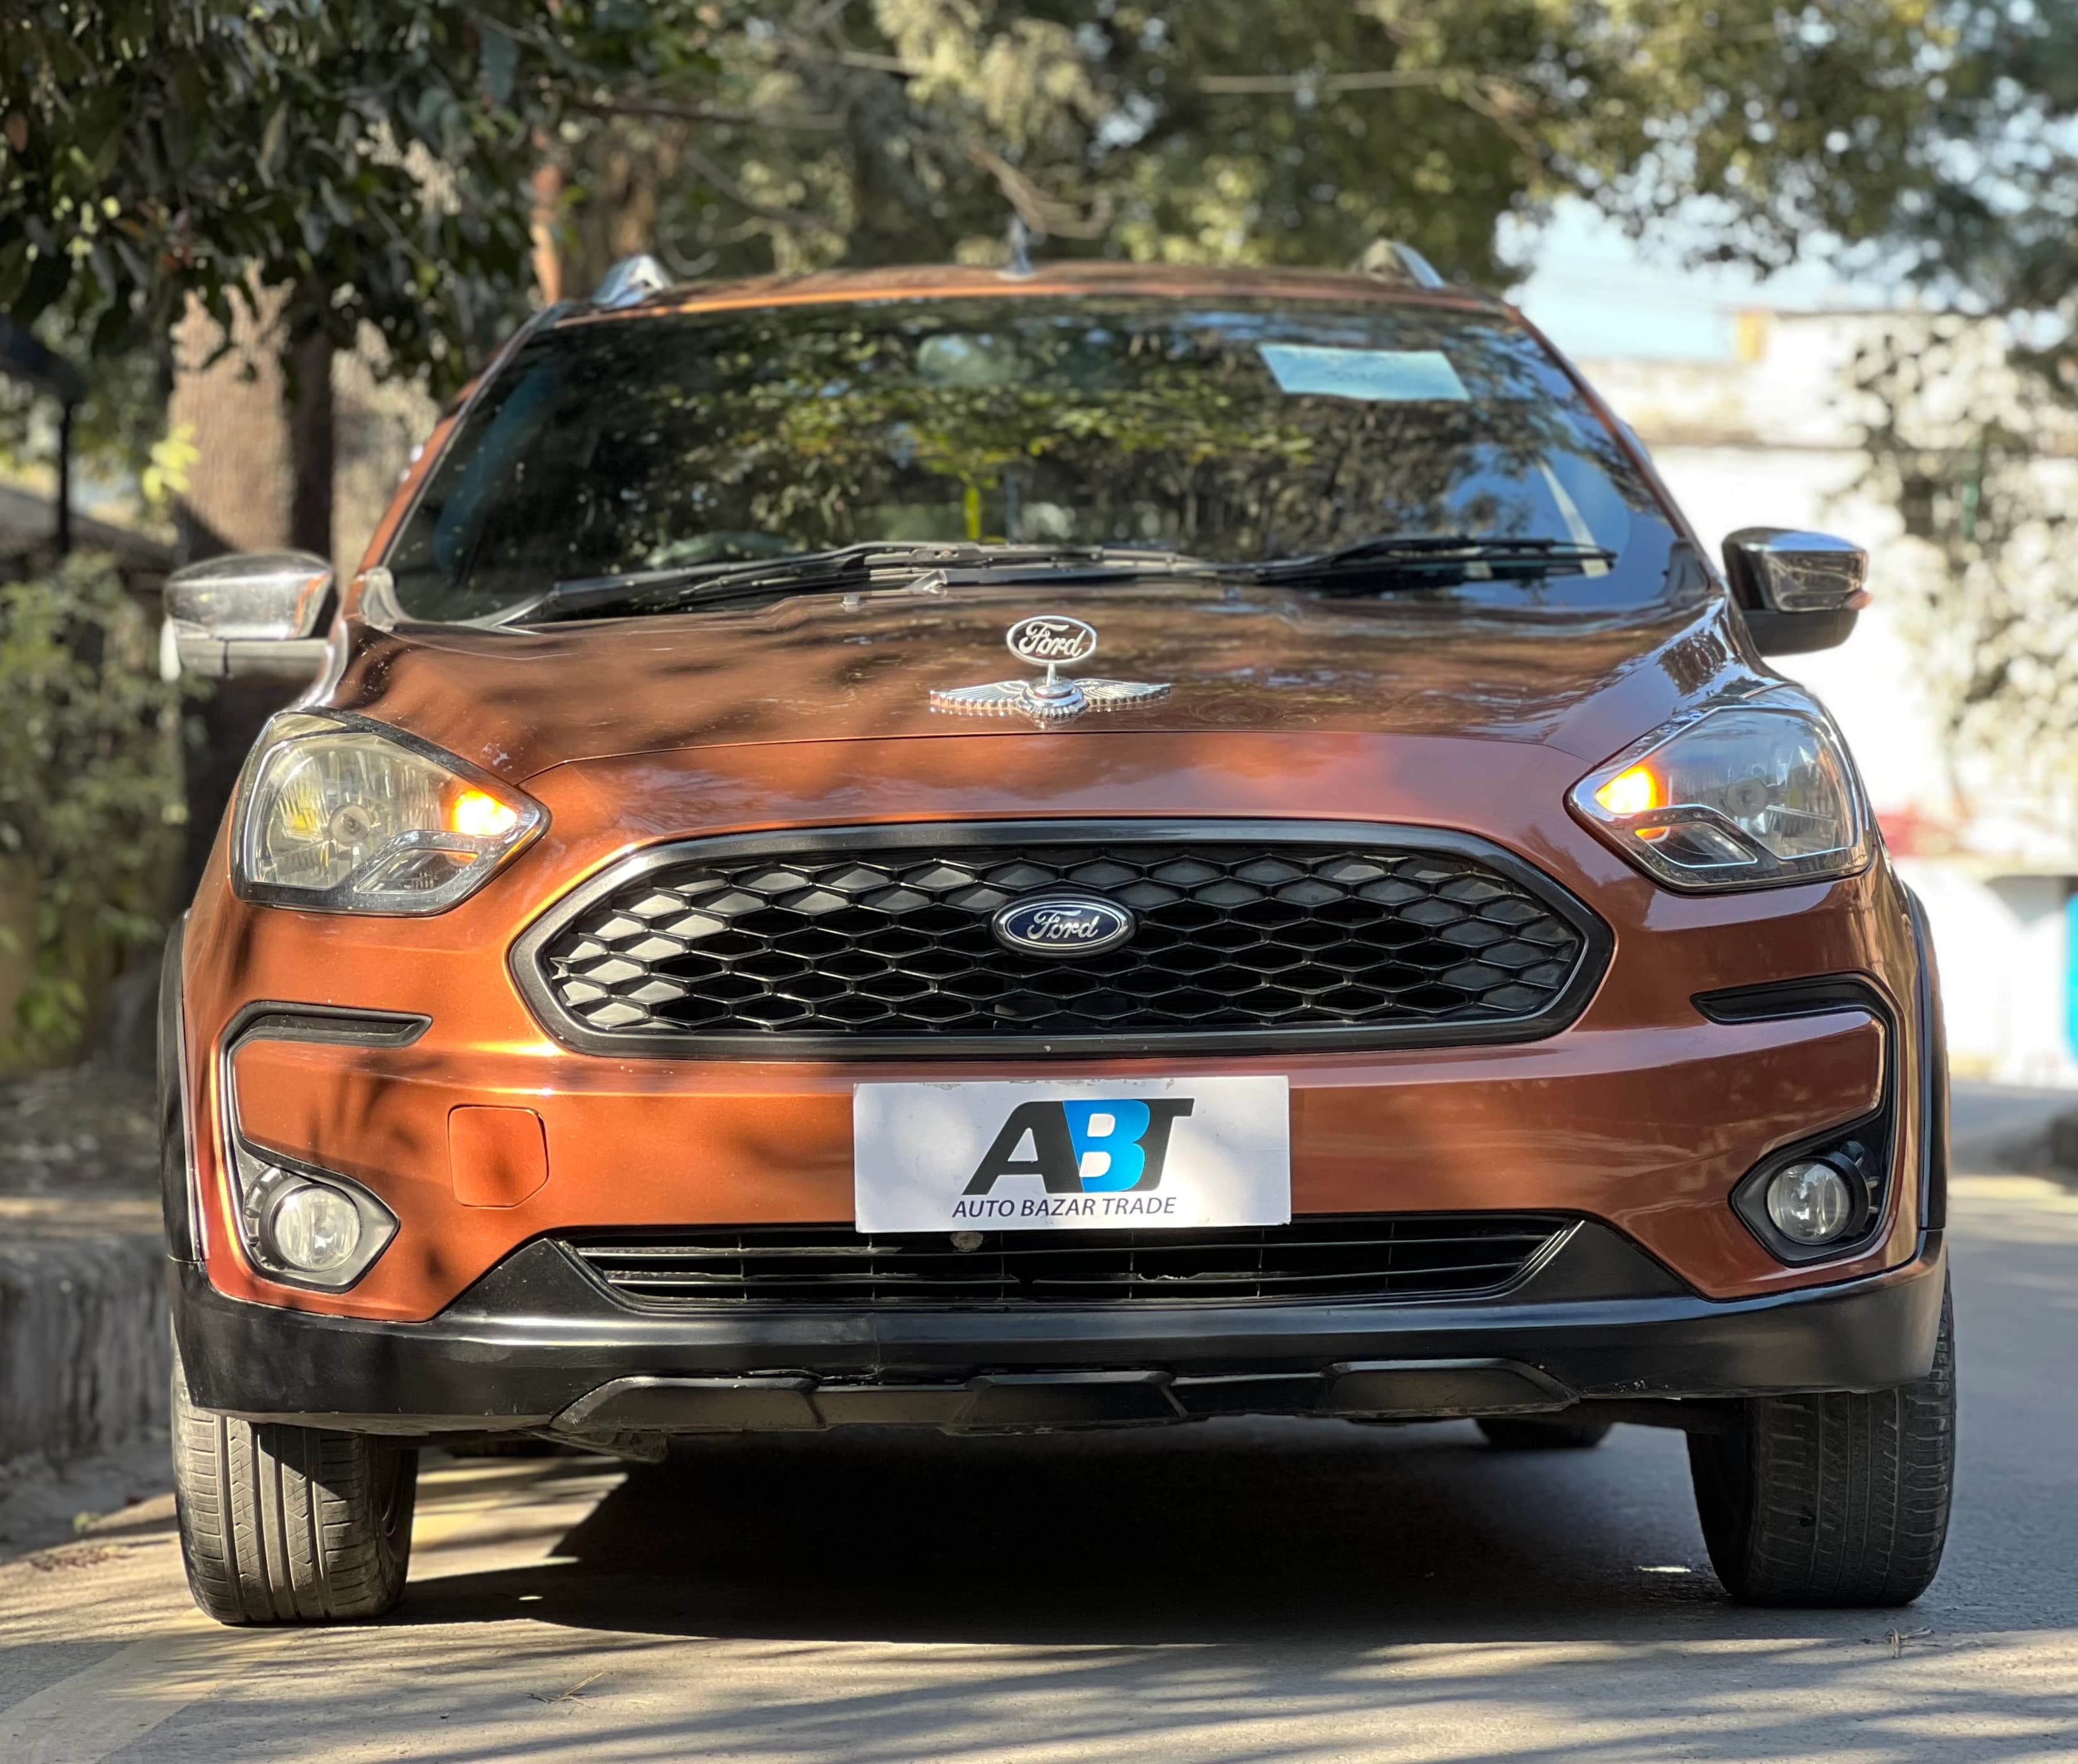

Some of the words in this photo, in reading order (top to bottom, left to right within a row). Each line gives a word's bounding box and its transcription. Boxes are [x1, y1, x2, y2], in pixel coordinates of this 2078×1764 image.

[1019, 621, 1087, 657] Ford
[1026, 909, 1100, 940] Ford
[961, 1097, 1195, 1196] ABT
[952, 1199, 1015, 1218] AUTO
[1020, 1198, 1095, 1217] BAZAR
[1104, 1196, 1177, 1215] TRADE
